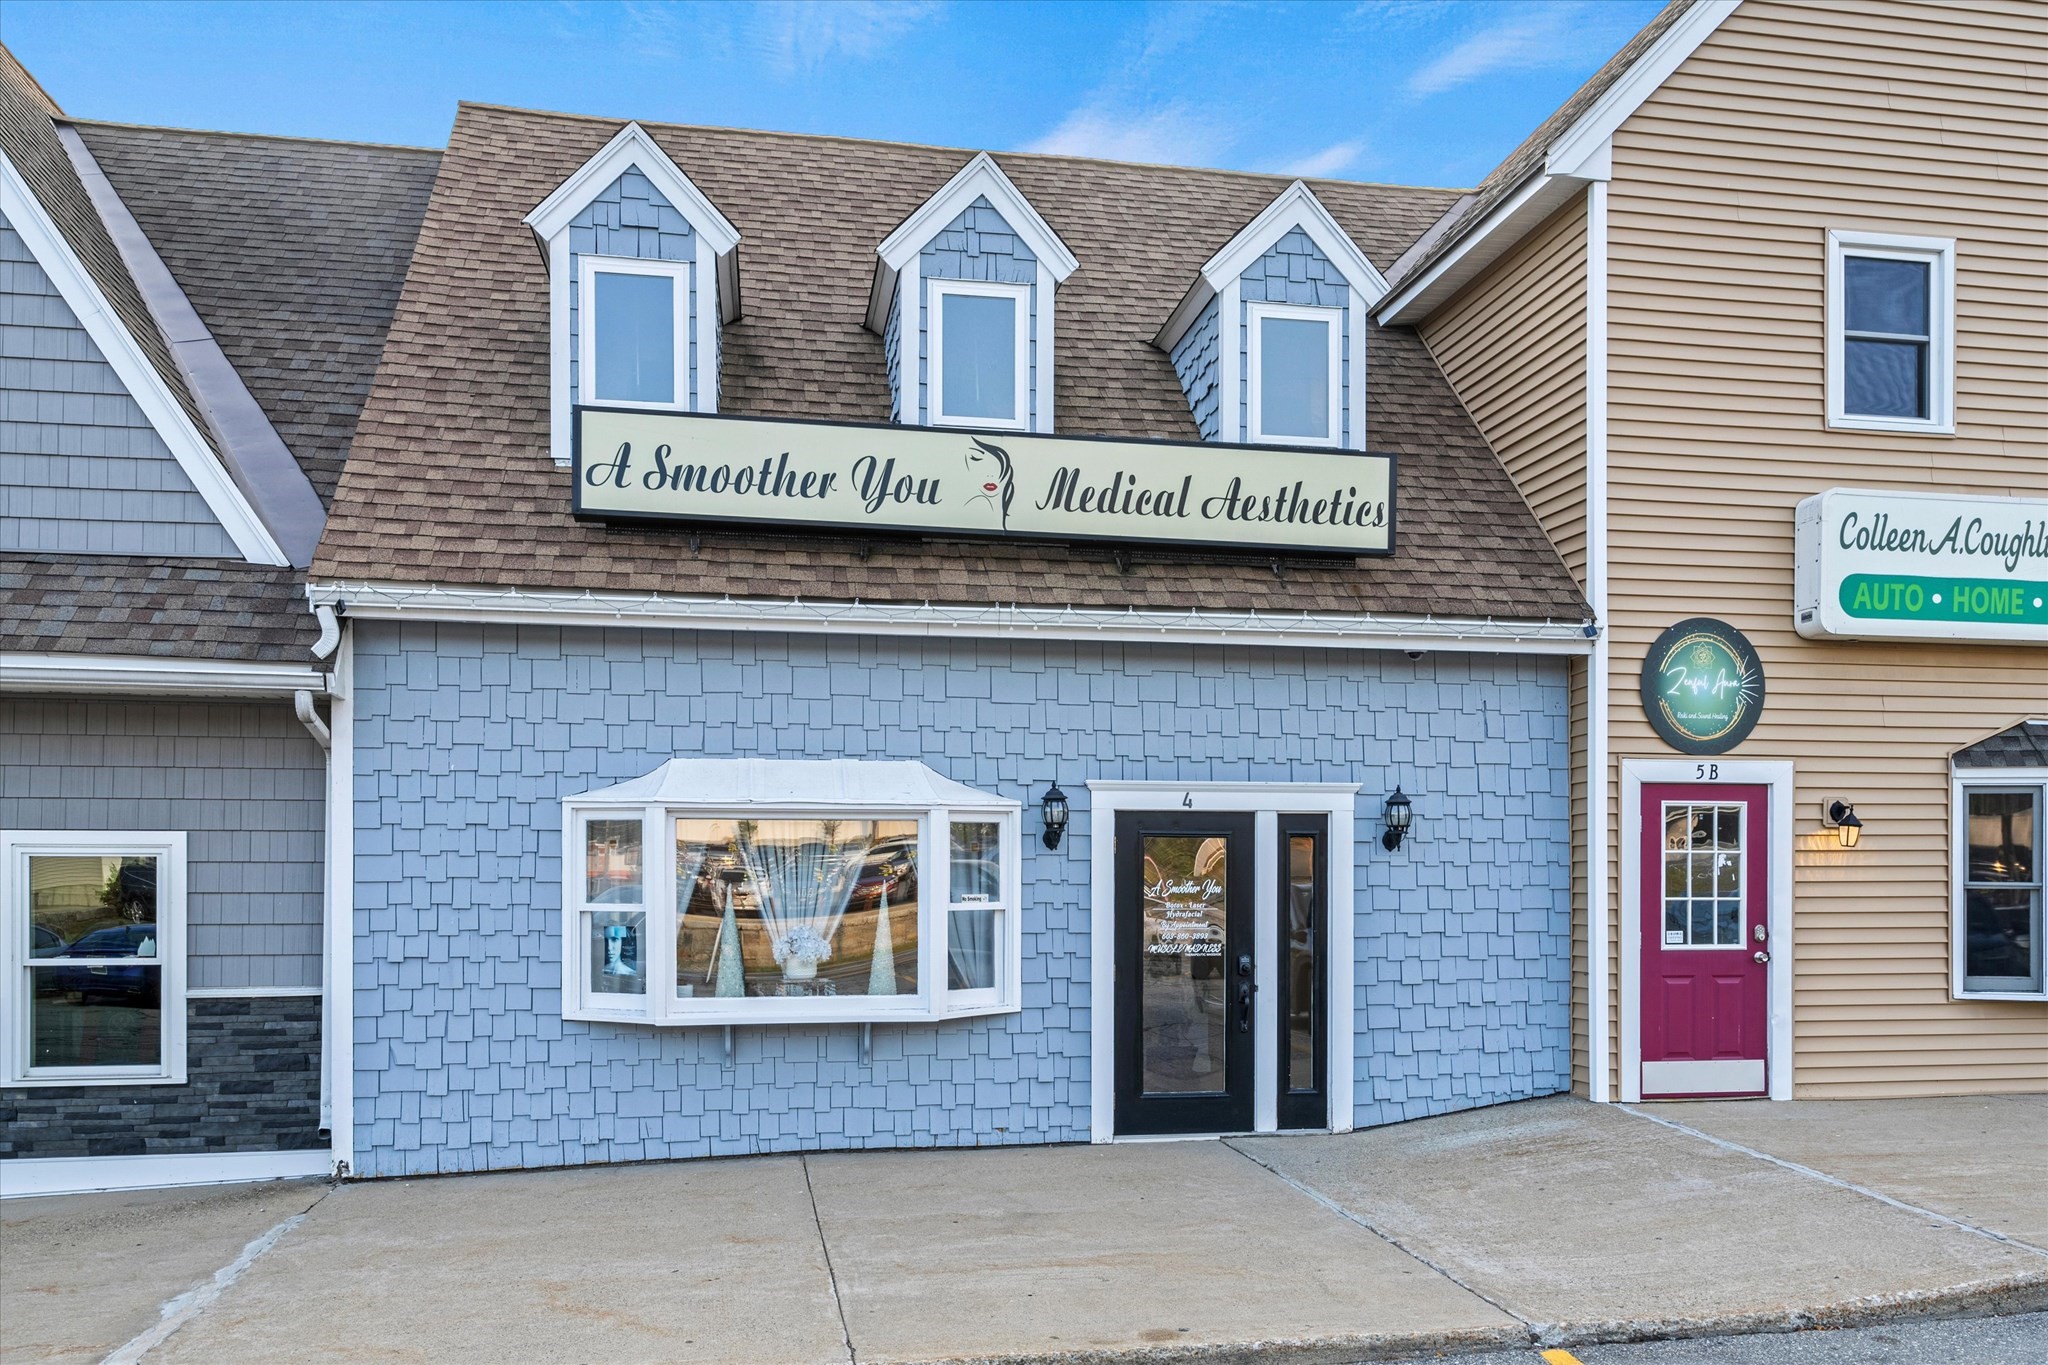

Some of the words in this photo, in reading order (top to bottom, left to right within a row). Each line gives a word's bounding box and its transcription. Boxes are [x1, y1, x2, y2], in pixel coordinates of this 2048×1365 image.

[585, 441, 632, 489] A
[643, 443, 838, 499] Smoother
[851, 455, 943, 514] You
[1035, 466, 1192, 518] Medical
[1201, 476, 1390, 528] Aesthetics
[1839, 511, 1929, 553] Colleen
[1852, 582, 1924, 612] AUTO
[1953, 585, 2025, 616] HOME
[1666, 666, 1709, 695] Zenful
[1711, 668, 1740, 700] Aura
[1182, 792, 1193, 808] 4
[1149, 879, 1162, 897] A
[1161, 879, 1200, 897] Smoother
[1202, 879, 1222, 900] You
[1170, 920, 1209, 931] Appointment
[1183, 943, 1222, 954] MADNESS
